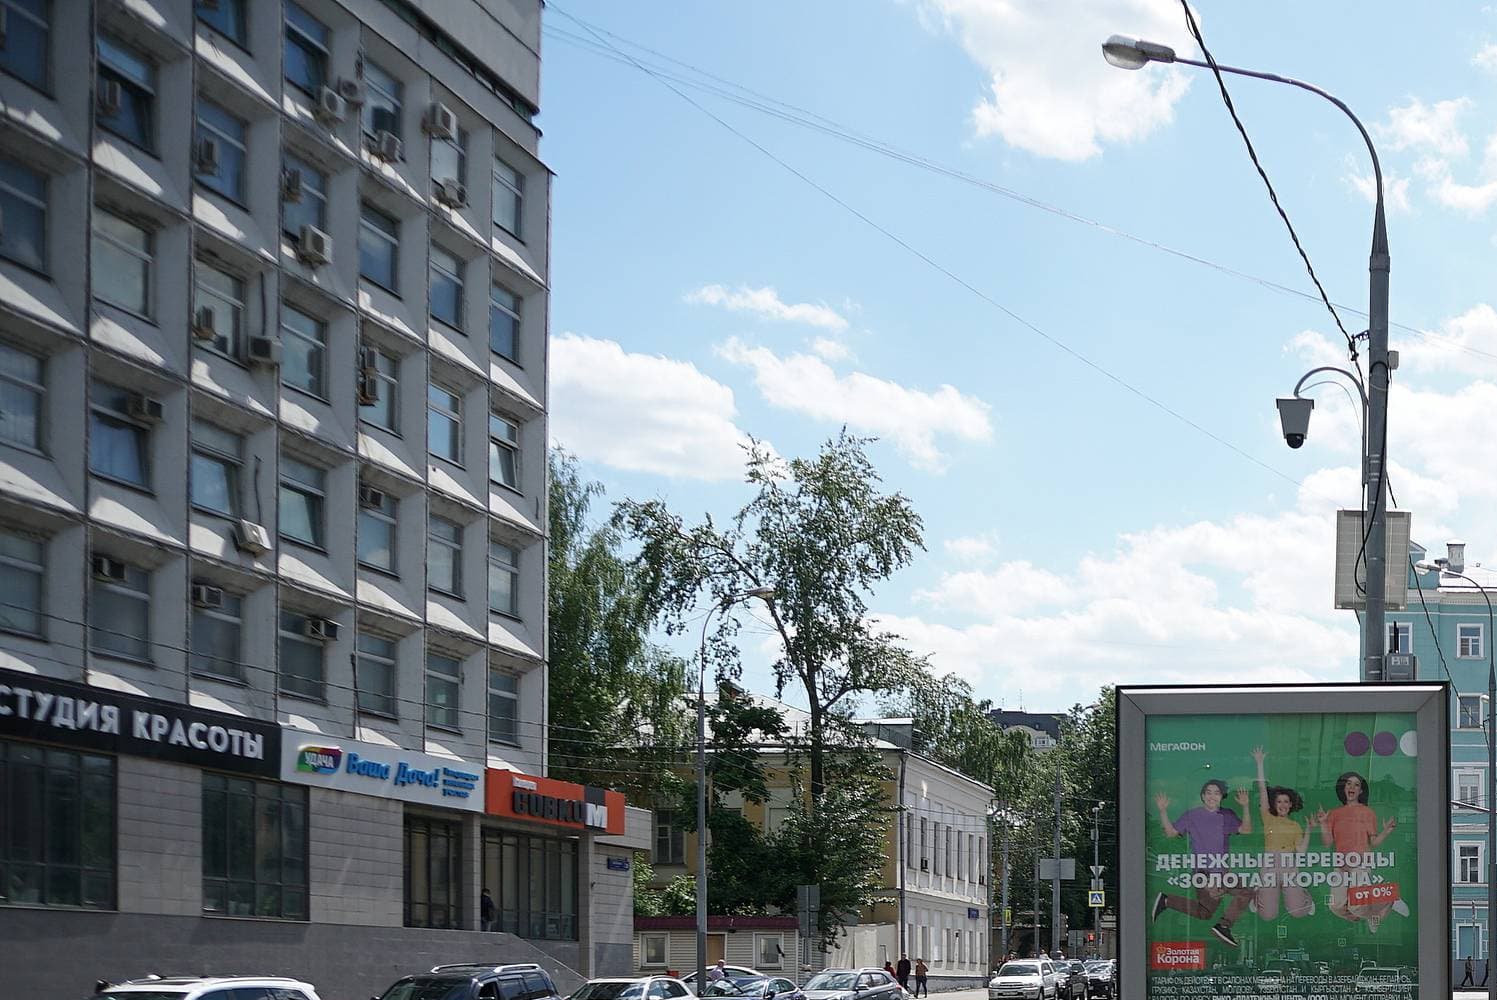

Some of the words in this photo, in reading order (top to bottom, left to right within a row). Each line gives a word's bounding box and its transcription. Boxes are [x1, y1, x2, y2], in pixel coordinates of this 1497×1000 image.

[0, 683, 120, 736] СТУДИЯ
[132, 709, 264, 760] КРАСОТЫ
[304, 751, 334, 769] УДАЧА
[513, 788, 608, 829] СОВКОМ
[1156, 852, 1275, 871] ДЕНЕЖНЫЕ
[1280, 851, 1395, 870] ПЕРЕВОДЫ
[1166, 872, 1278, 888] «ЗОЛОТАЯ
[1282, 871, 1384, 888] КОРОНА»
[1355, 891, 1369, 899] от
[1157, 953, 1200, 965] Корона
[1166, 947, 1200, 955] Золотая
